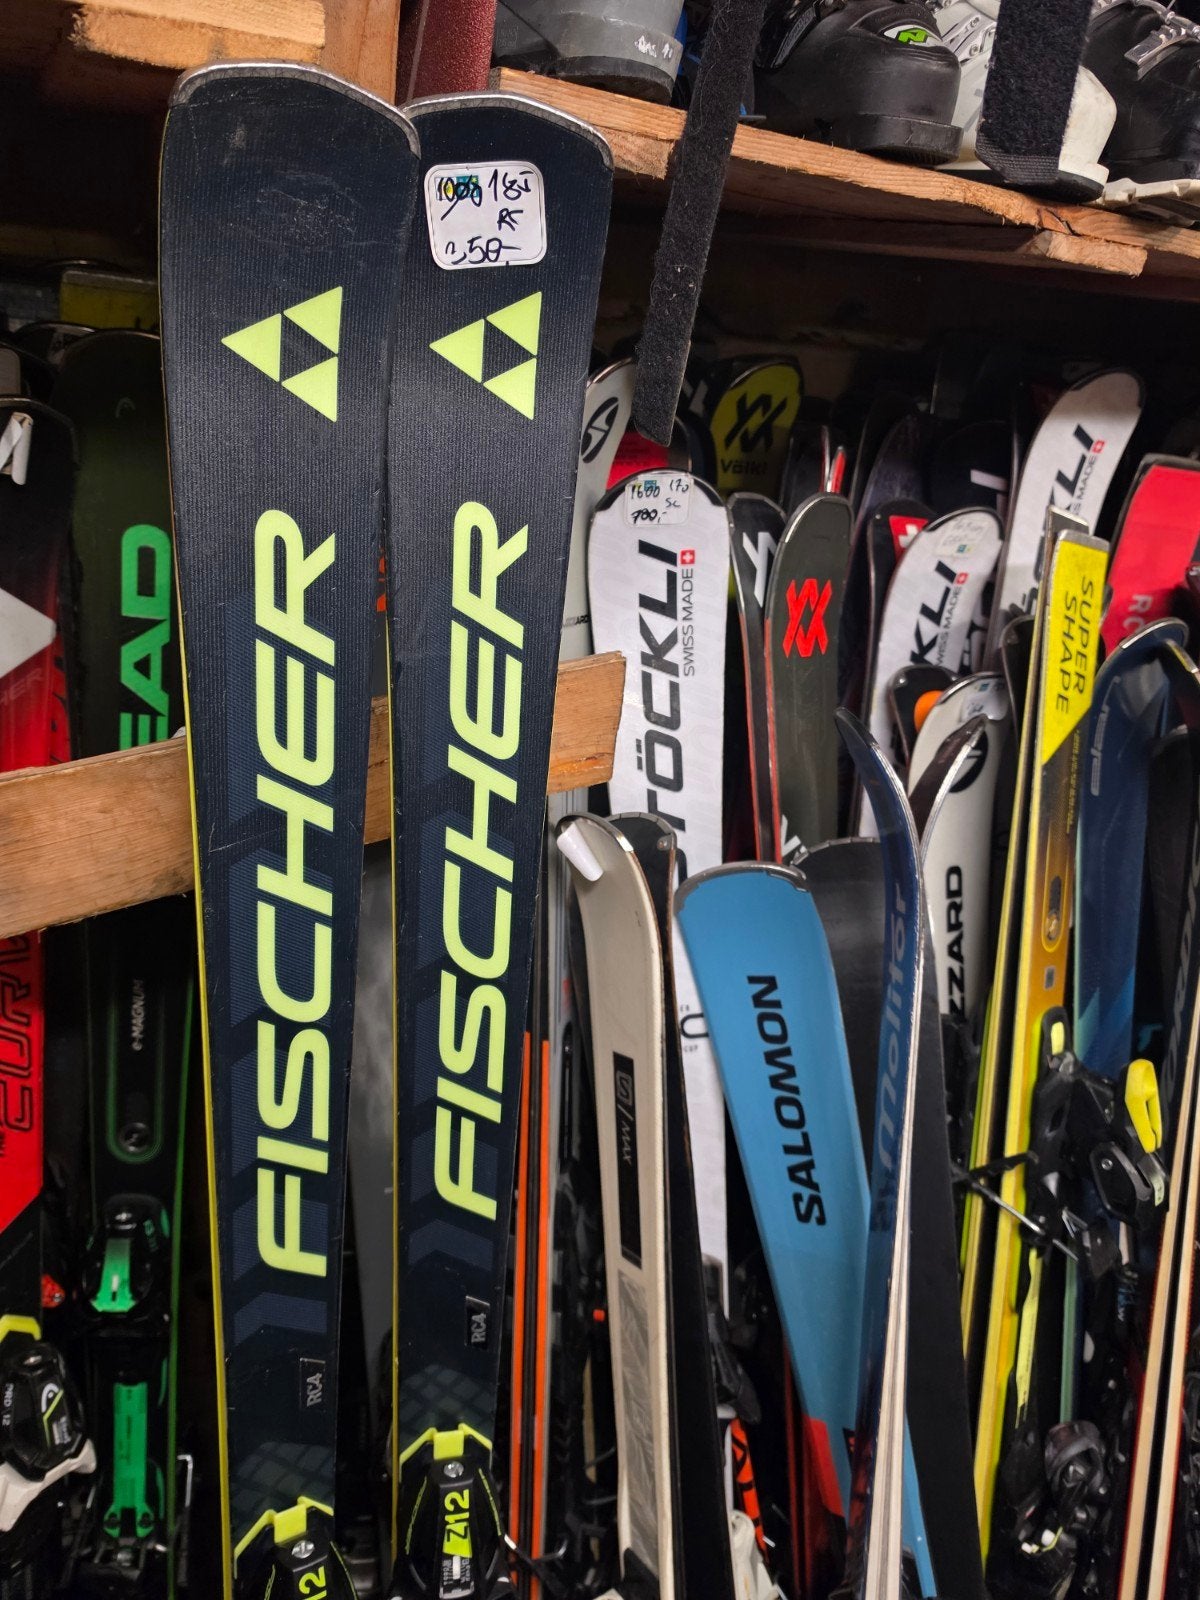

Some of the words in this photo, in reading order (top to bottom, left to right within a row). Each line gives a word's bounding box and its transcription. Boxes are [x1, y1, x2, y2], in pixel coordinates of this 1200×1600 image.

[119, 524, 171, 751] EAD
[681, 568, 694, 621] MADE
[682, 623, 695, 676] SWISS
[1055, 592, 1077, 714] SHAPE
[1073, 576, 1094, 694] SUPER
[636, 539, 688, 885] TÖCKLI
[254, 509, 335, 1278] FISCHER
[434, 501, 528, 1221] FISCHER
[946, 865, 967, 1025] ZZARD
[747, 974, 827, 1227] SALOMON
[298, 1565, 328, 1600] 12
[444, 1488, 470, 1542] Z12
